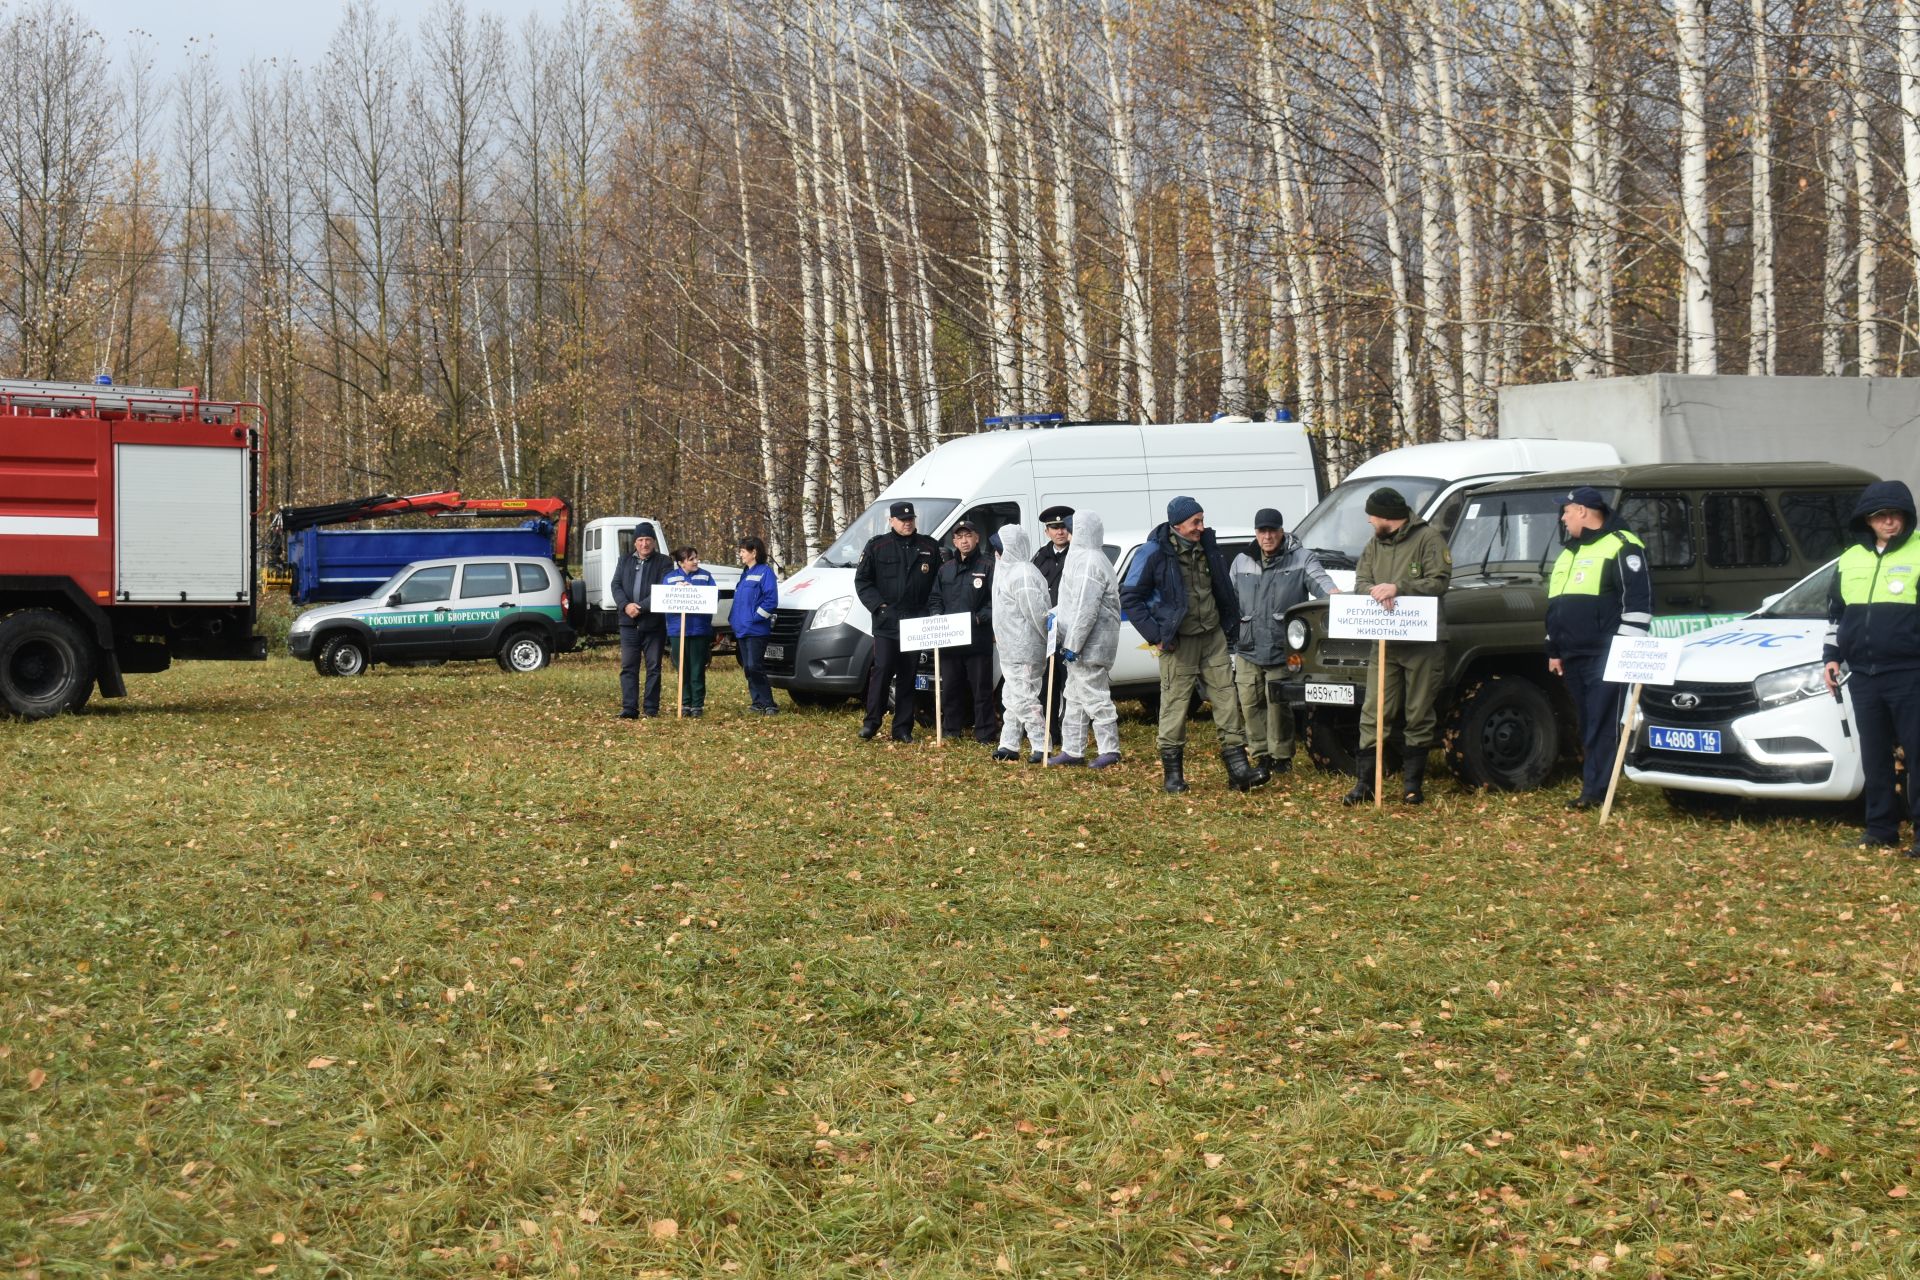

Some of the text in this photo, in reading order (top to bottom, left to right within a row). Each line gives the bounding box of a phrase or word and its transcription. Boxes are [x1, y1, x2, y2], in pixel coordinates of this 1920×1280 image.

[1366, 599, 1400, 608] ГРУА
[1346, 608, 1420, 617] РЕГУЛИРОВАНИЯ
[368, 614, 416, 626] ГОСКОМИТЕТ
[420, 613, 429, 624] РТ
[434, 612, 445, 622] ПО
[447, 610, 501, 622] БИОРЕСУРСАМ
[922, 616, 948, 625] ГРУППА
[1337, 617, 1428, 628] ЧИСЛЕННОСТИ ДИКИХ
[921, 624, 950, 633] ОХРАНЫ
[1356, 628, 1408, 637] ЖИВОТНЫХ
[907, 630, 965, 642] ОБЩЕСТВЕННОГО
[1683, 632, 1804, 648] ДПС
[920, 638, 952, 648] ПОРЯДКА
[1633, 640, 1659, 649] ГРУППА
[1620, 650, 1669, 661] ОБЕСПЕЧЕНИЯ
[1617, 660, 1666, 671] ПРОПУСКНОГО
[1623, 671, 1654, 681] РЕЖИМА
[1655, 730, 1716, 749] А 4808 16
